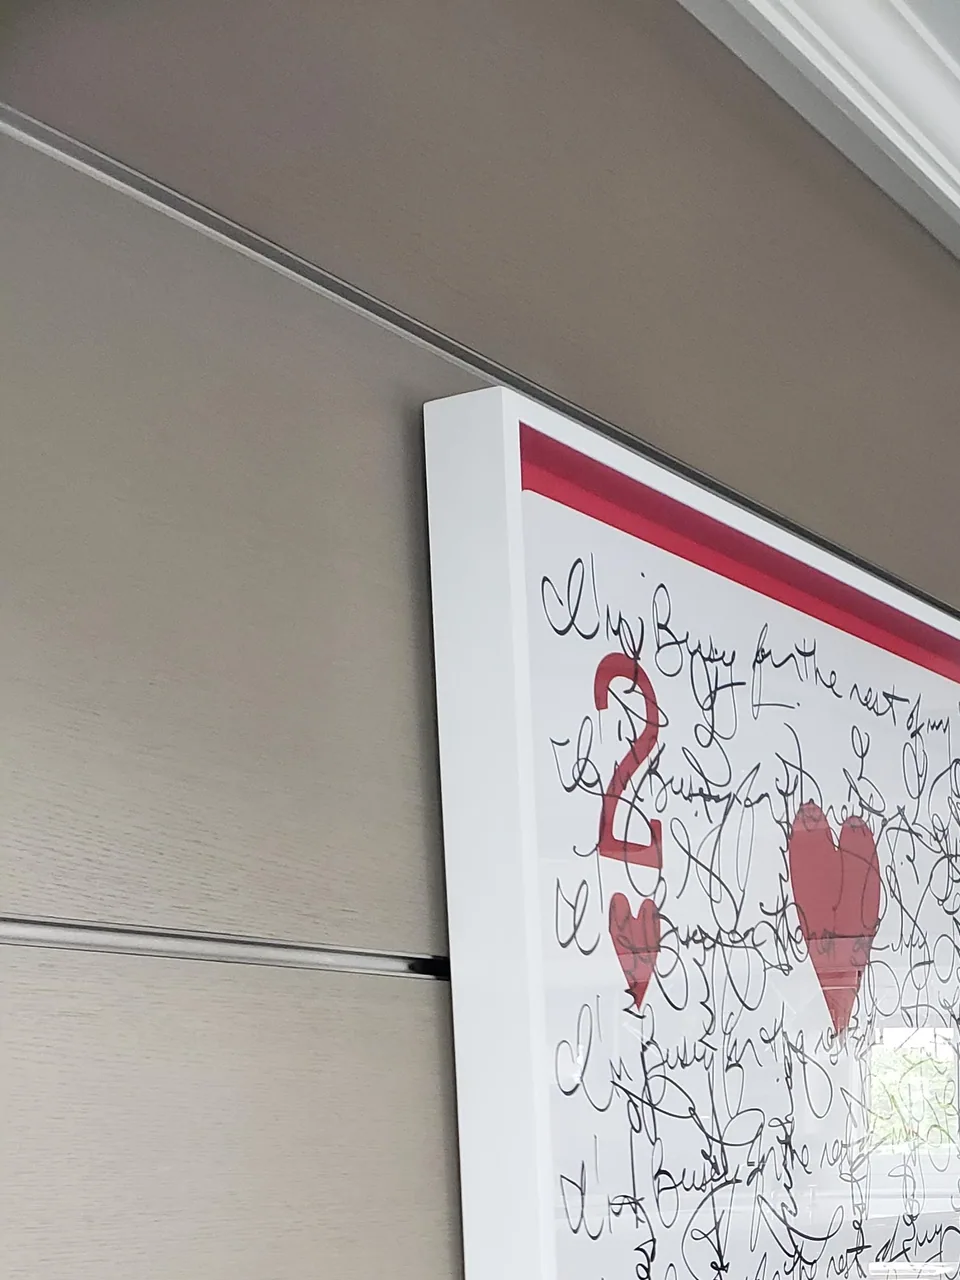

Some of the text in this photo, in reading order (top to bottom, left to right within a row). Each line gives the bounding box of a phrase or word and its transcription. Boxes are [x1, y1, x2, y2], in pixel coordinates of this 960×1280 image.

[542, 553, 643, 660] I'm
[653, 583, 746, 740] Busy
[752, 623, 803, 720] for
[795, 638, 843, 698] the
[850, 684, 910, 727] rest
[594, 652, 662, 869] 2
[650, 744, 735, 900] Busy
[652, 1138, 742, 1262] Busy
[827, 1245, 872, 1279] rest
